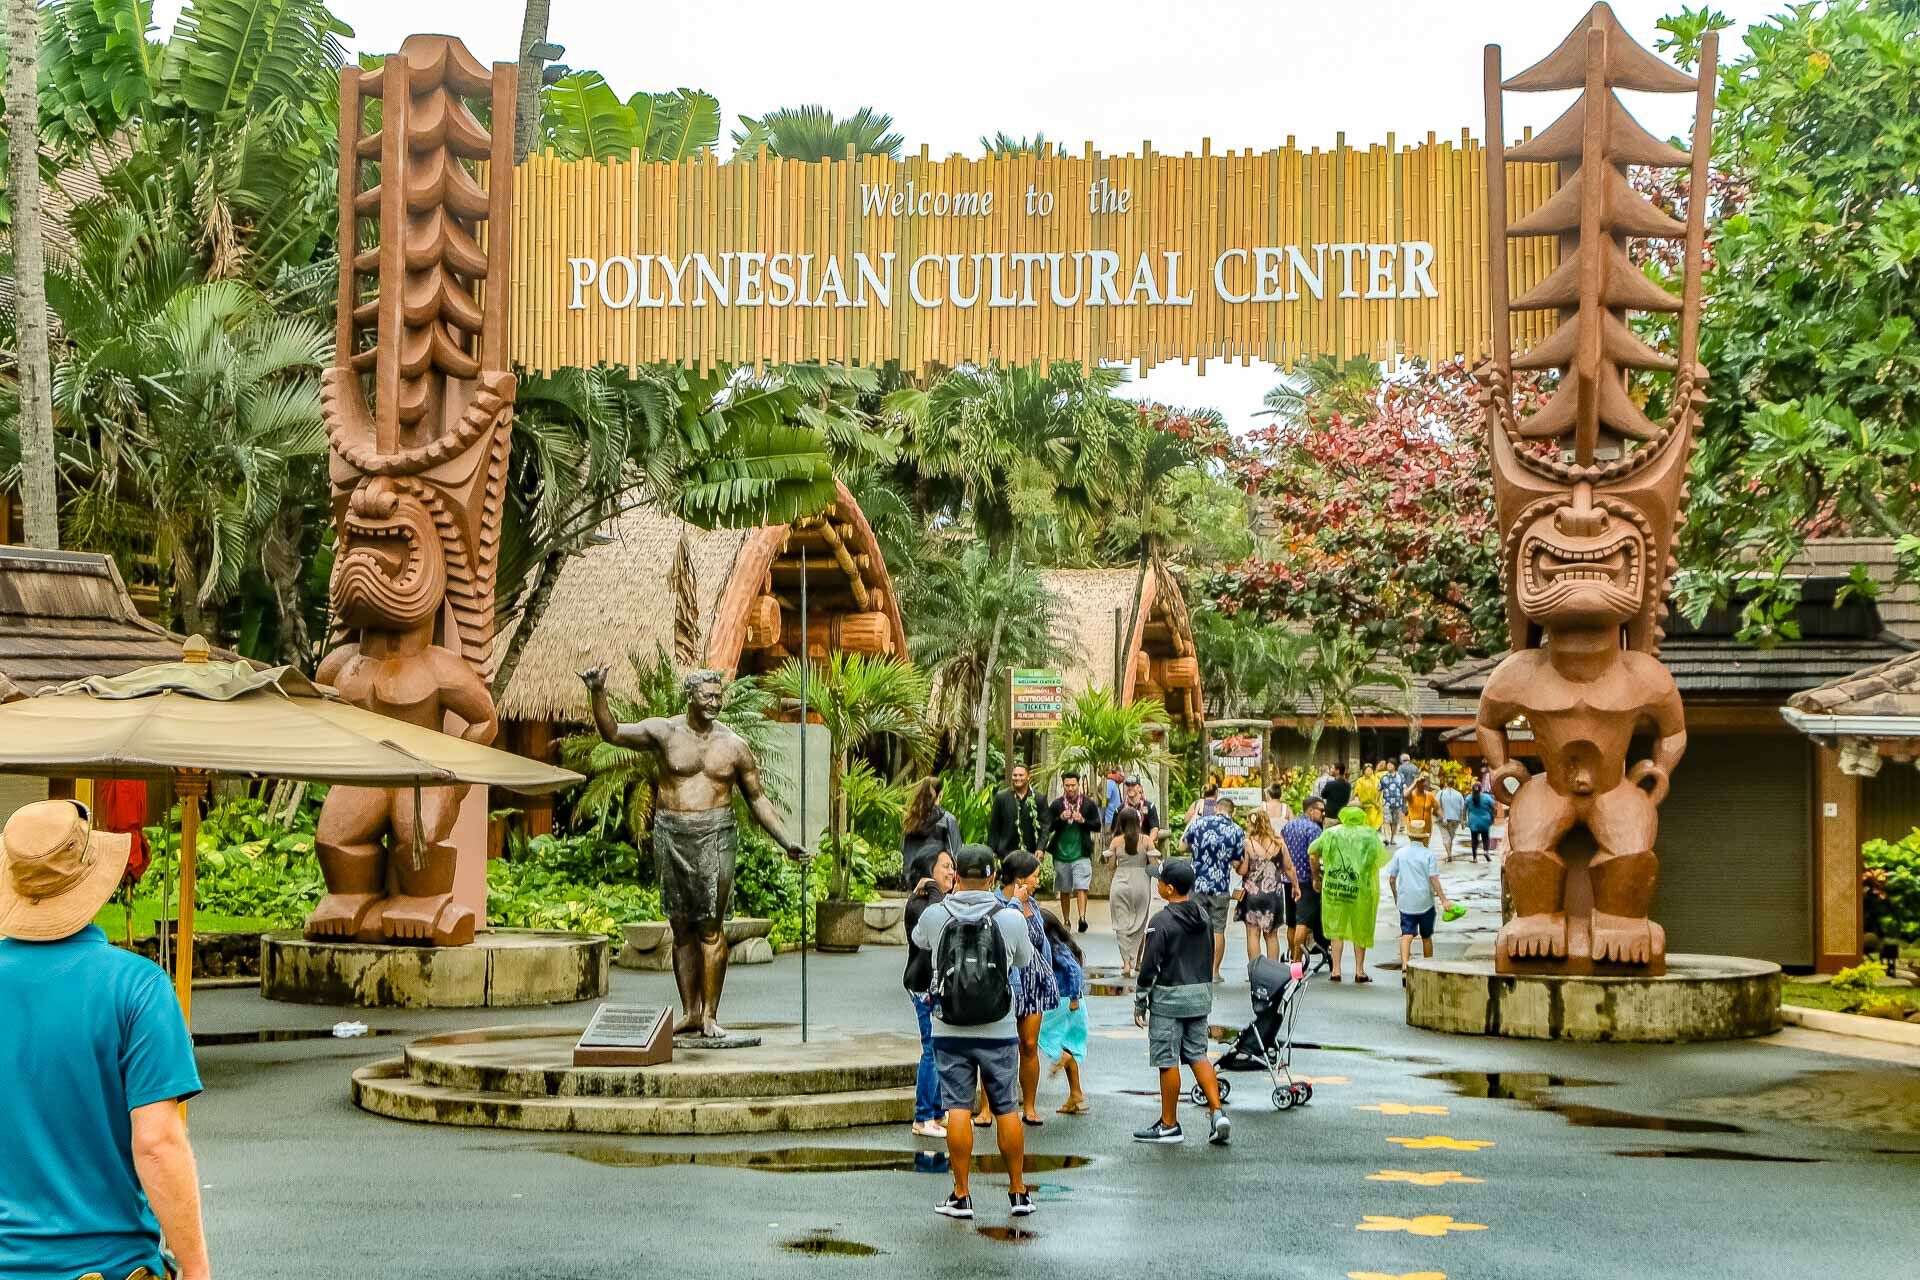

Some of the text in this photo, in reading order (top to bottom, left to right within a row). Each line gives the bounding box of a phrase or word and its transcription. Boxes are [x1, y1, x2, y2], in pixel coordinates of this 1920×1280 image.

[860, 176, 1131, 217] Welcome to the
[567, 240, 1439, 310] POLYNESIAN CULTURAL CENTER
[1218, 756, 1241, 767] PRIME
[1224, 766, 1249, 777] DINING
